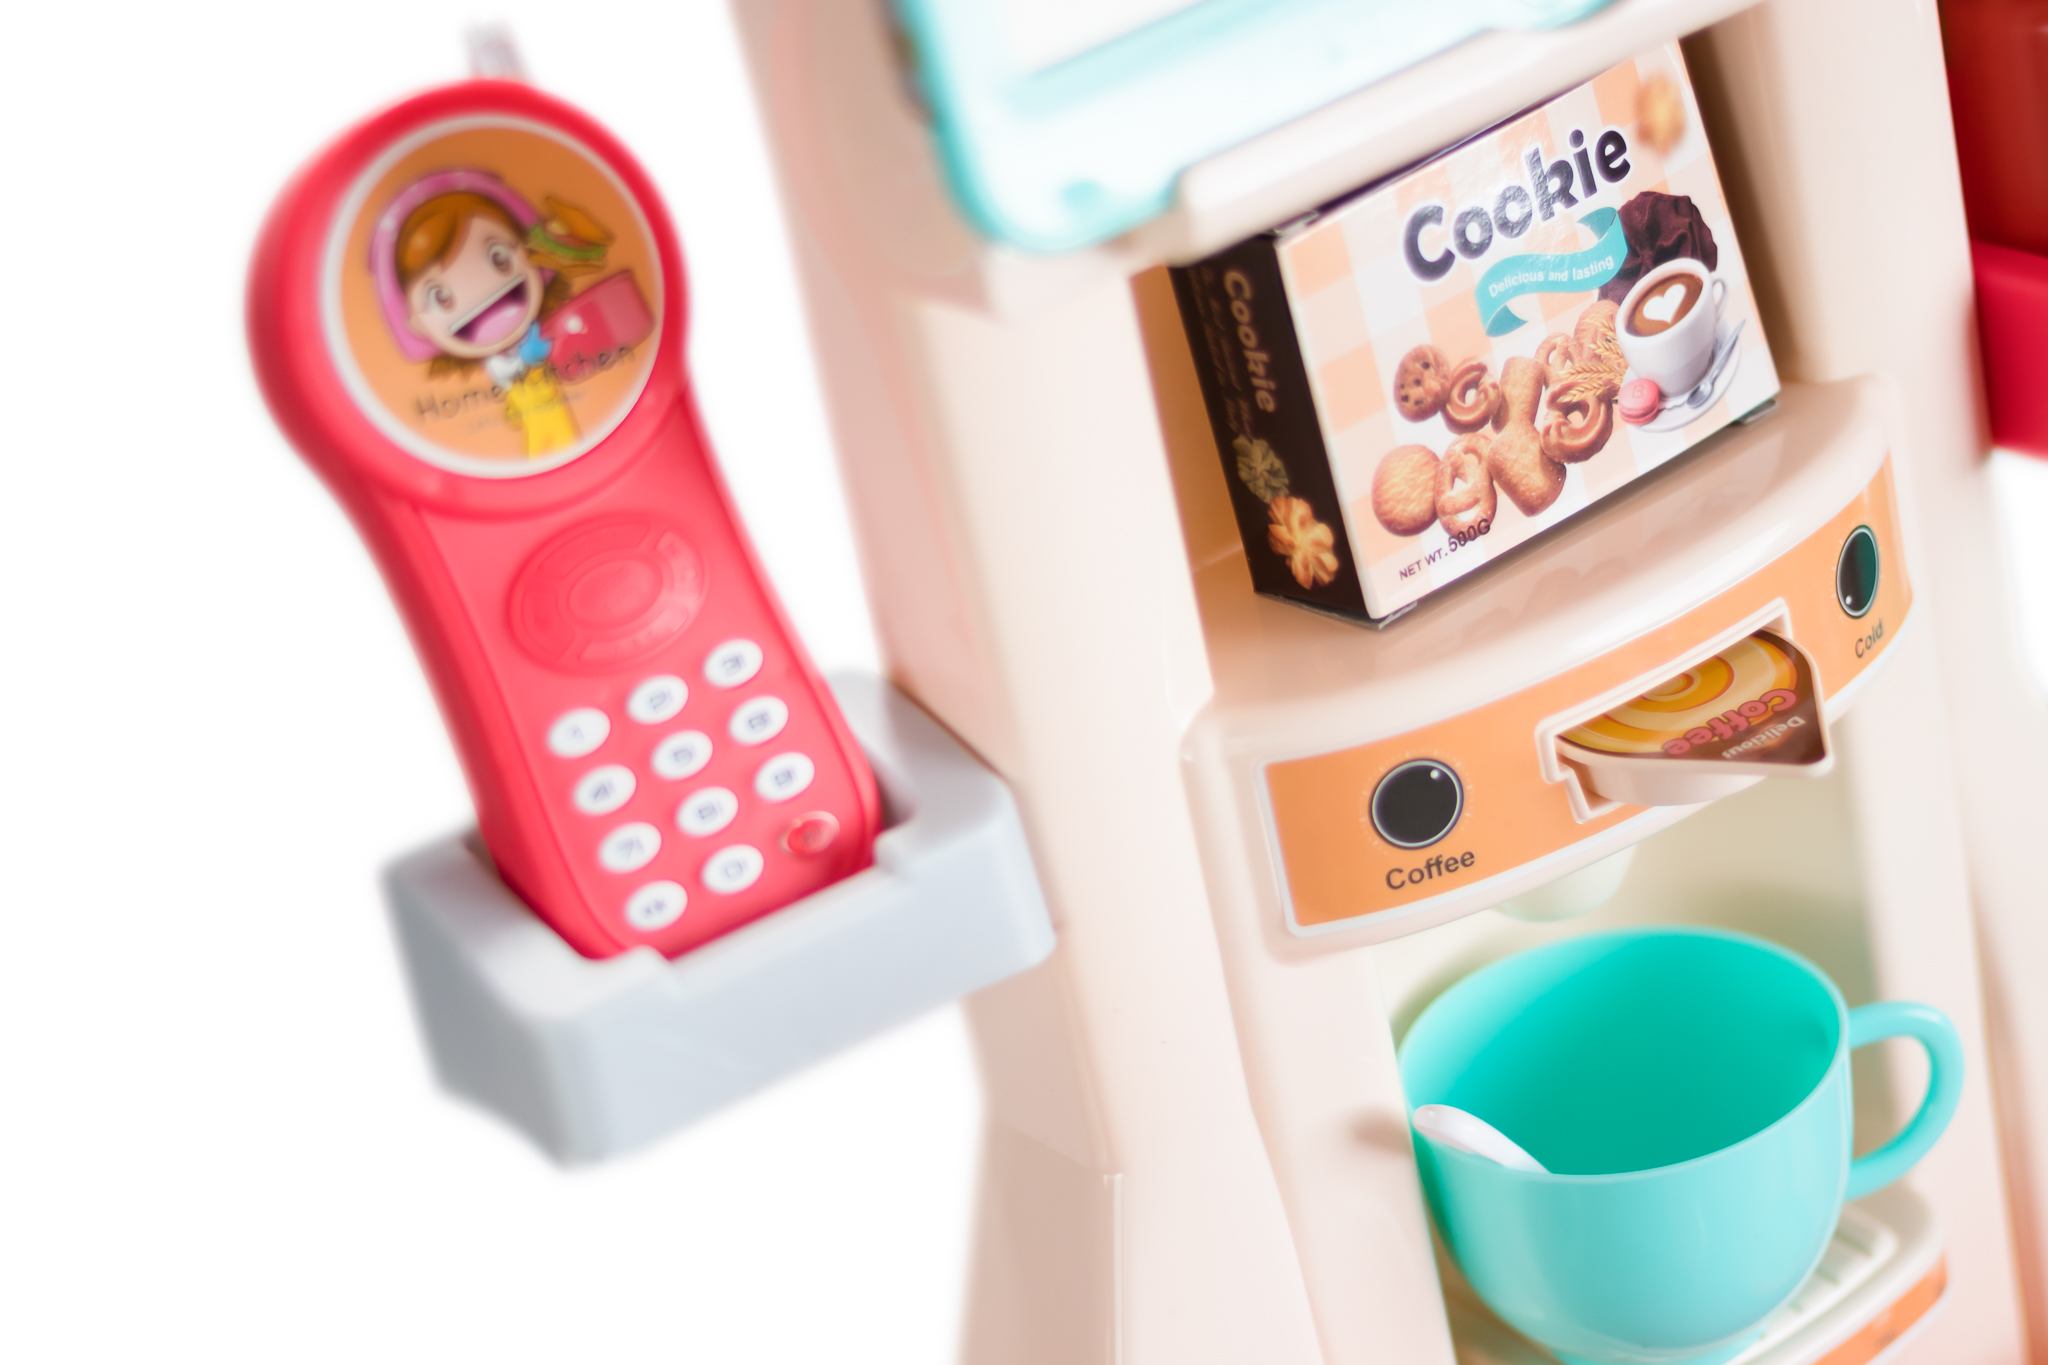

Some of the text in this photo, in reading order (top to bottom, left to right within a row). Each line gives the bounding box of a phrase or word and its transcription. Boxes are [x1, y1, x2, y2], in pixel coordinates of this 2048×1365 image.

[1403, 129, 1631, 282] Cookie
[1488, 254, 1615, 298] Delicious and lasting
[1223, 271, 1277, 413] Cookie
[1399, 518, 1491, 581] NET WT. 500G
[1855, 617, 1883, 659] Cold
[1661, 688, 1797, 755] Coffee
[1721, 715, 1805, 759] Delicious
[1385, 851, 1475, 890] Coffee
